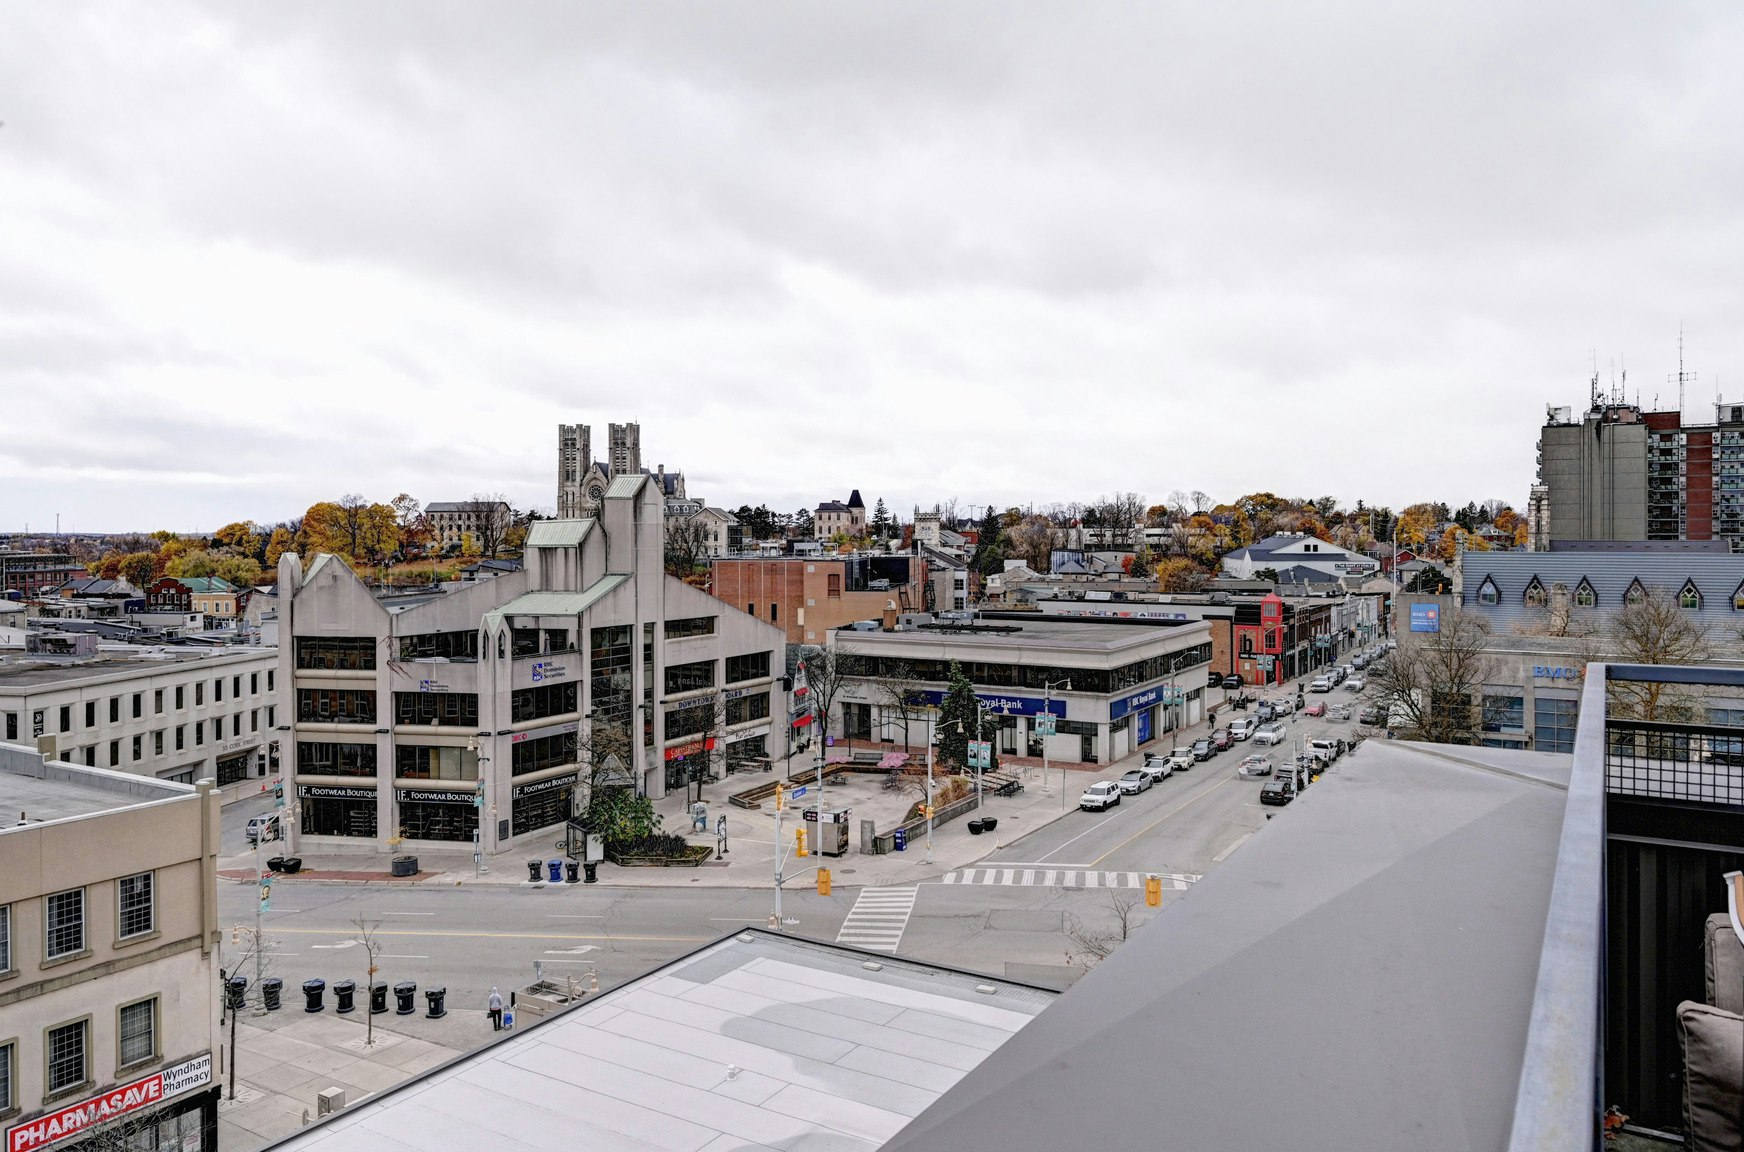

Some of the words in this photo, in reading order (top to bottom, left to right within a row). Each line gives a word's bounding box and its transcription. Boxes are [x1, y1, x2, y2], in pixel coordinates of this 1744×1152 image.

[1532, 666, 1578, 681] BMO
[1148, 690, 1157, 701] Bank
[980, 698, 999, 709] oyal
[1000, 699, 1023, 710] Bank
[311, 787, 346, 796] FOOTWEAR
[524, 782, 552, 793] FOOTWEAR
[411, 791, 446, 800] FOOTWEAR
[162, 1057, 210, 1084] Wyndham
[162, 1069, 210, 1094] Pharmacy
[14, 1078, 160, 1151] PHARMASAVE
